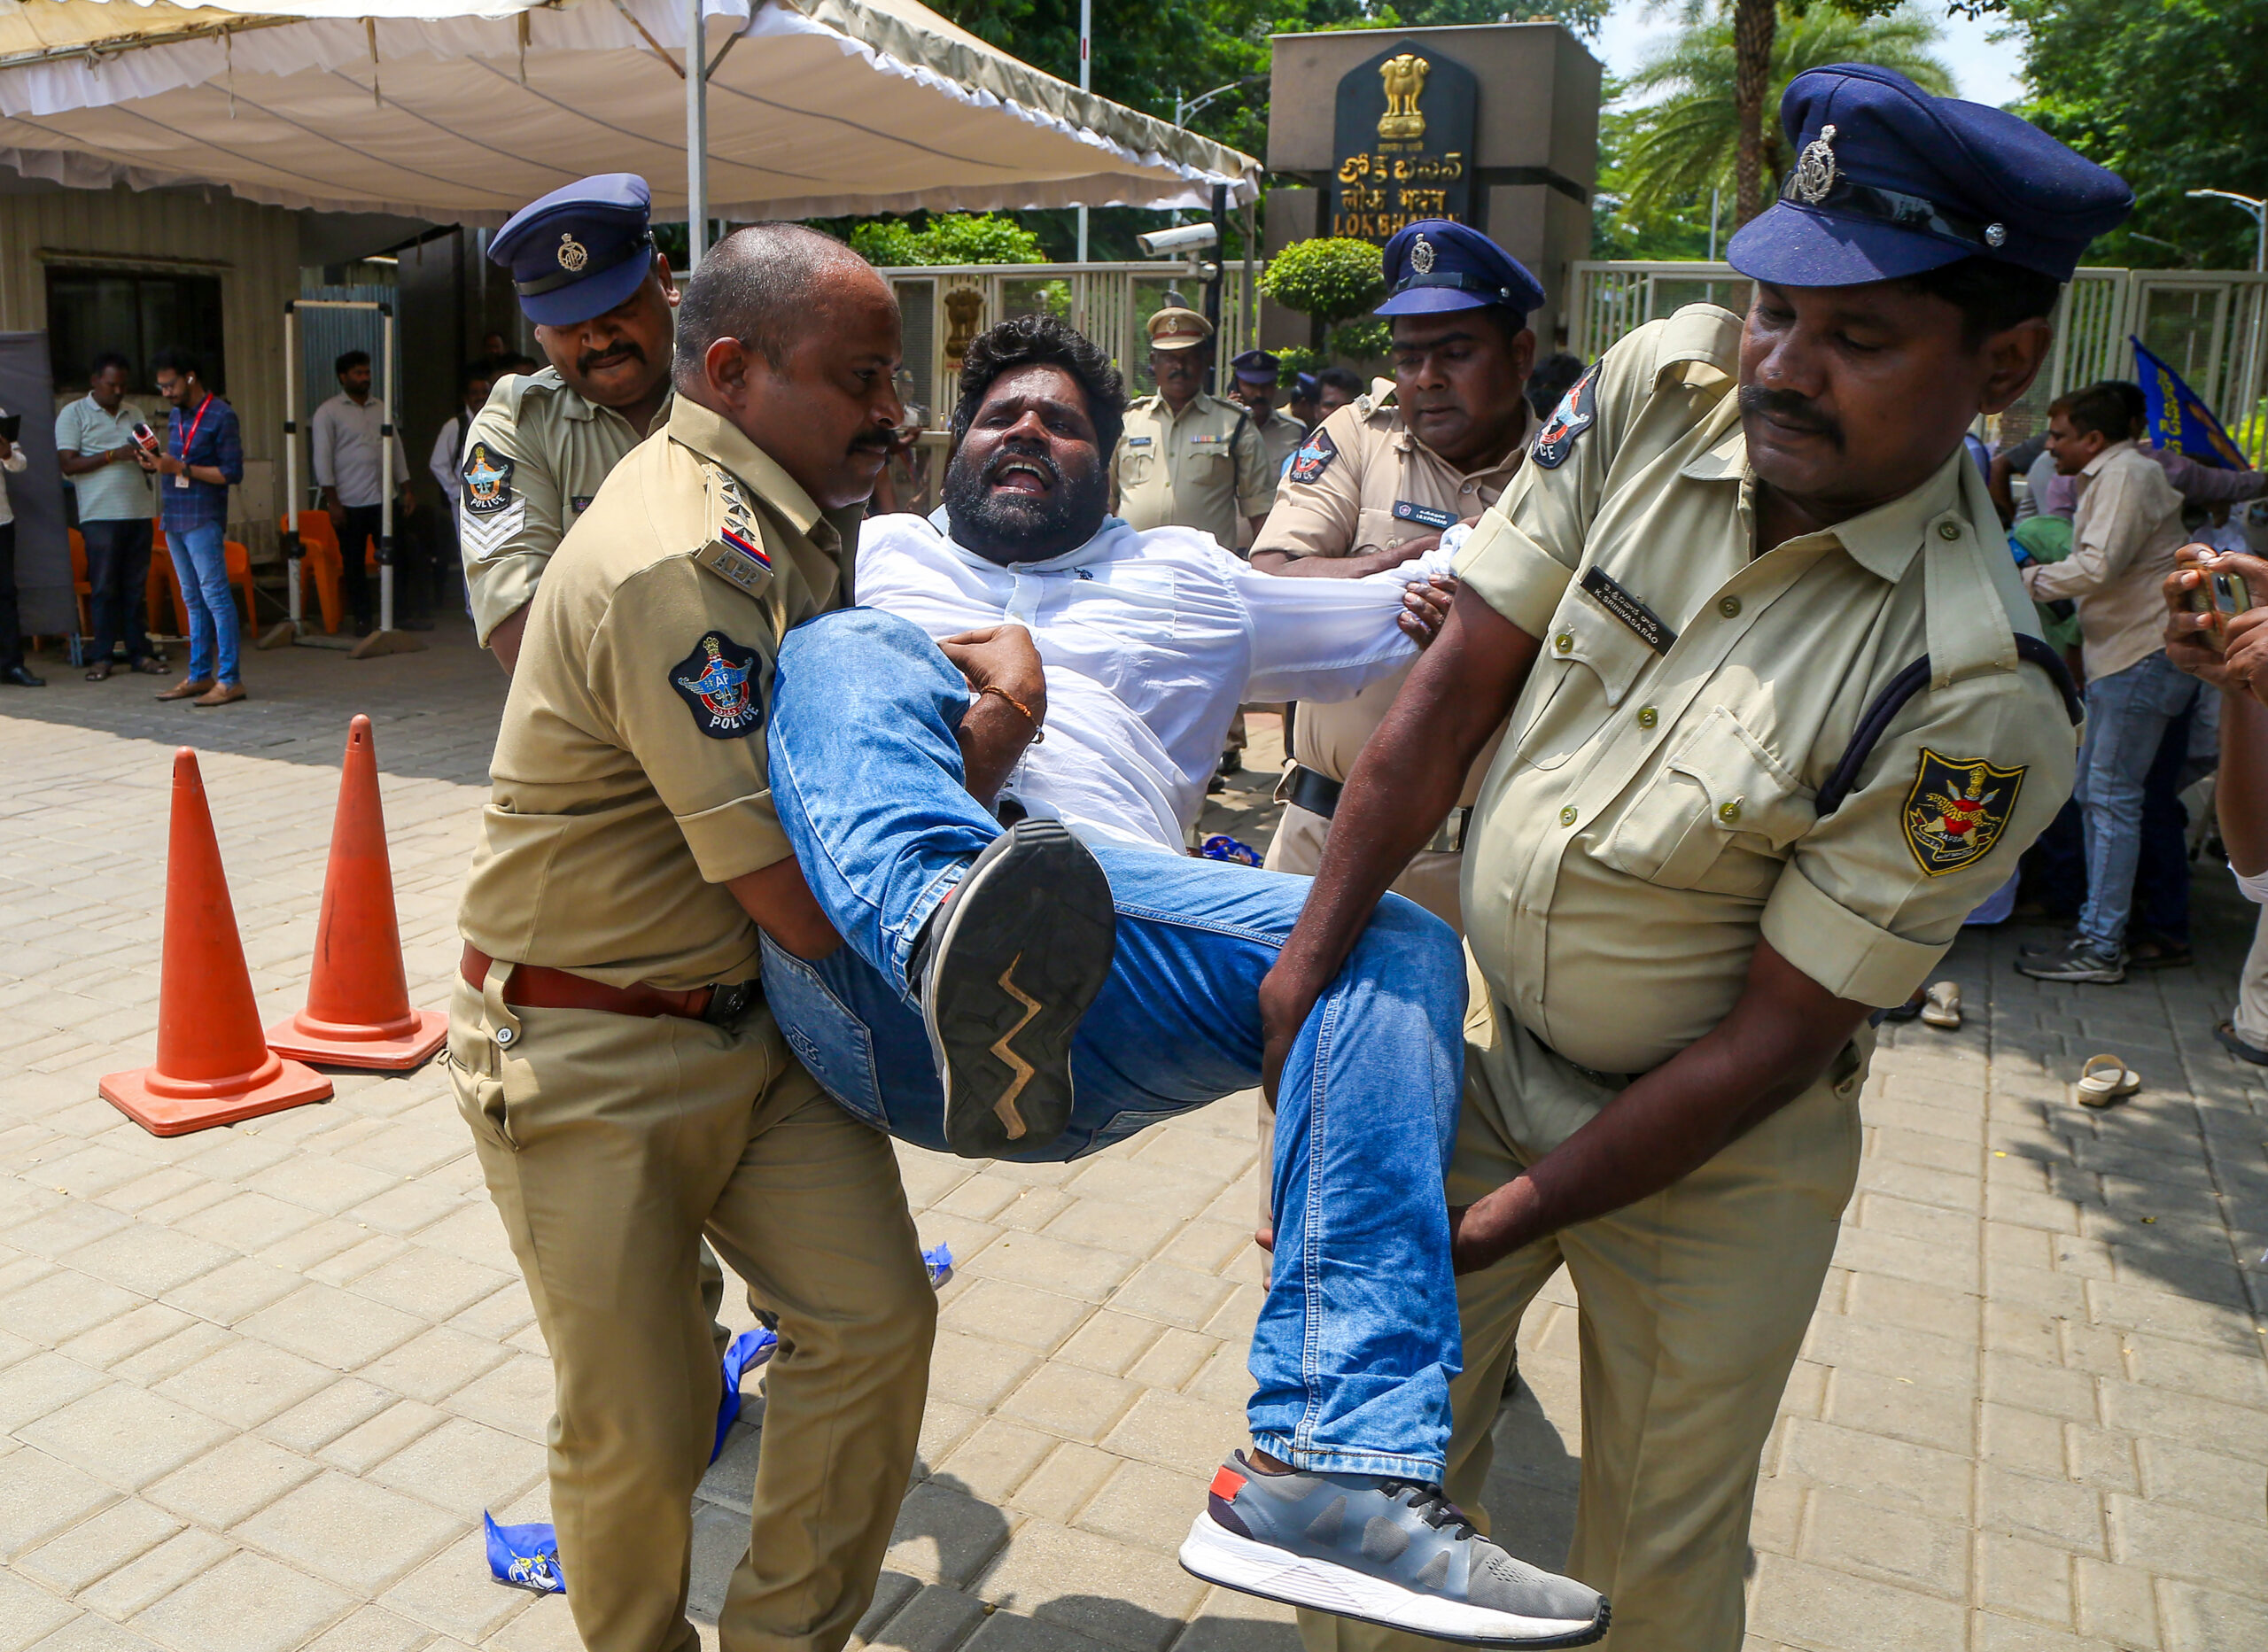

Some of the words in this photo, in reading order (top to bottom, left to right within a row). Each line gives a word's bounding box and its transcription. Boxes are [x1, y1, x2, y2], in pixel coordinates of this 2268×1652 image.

[1333, 213, 1374, 237] LOK
[470, 494, 506, 508] POLICE
[709, 703, 759, 729] POLICE
